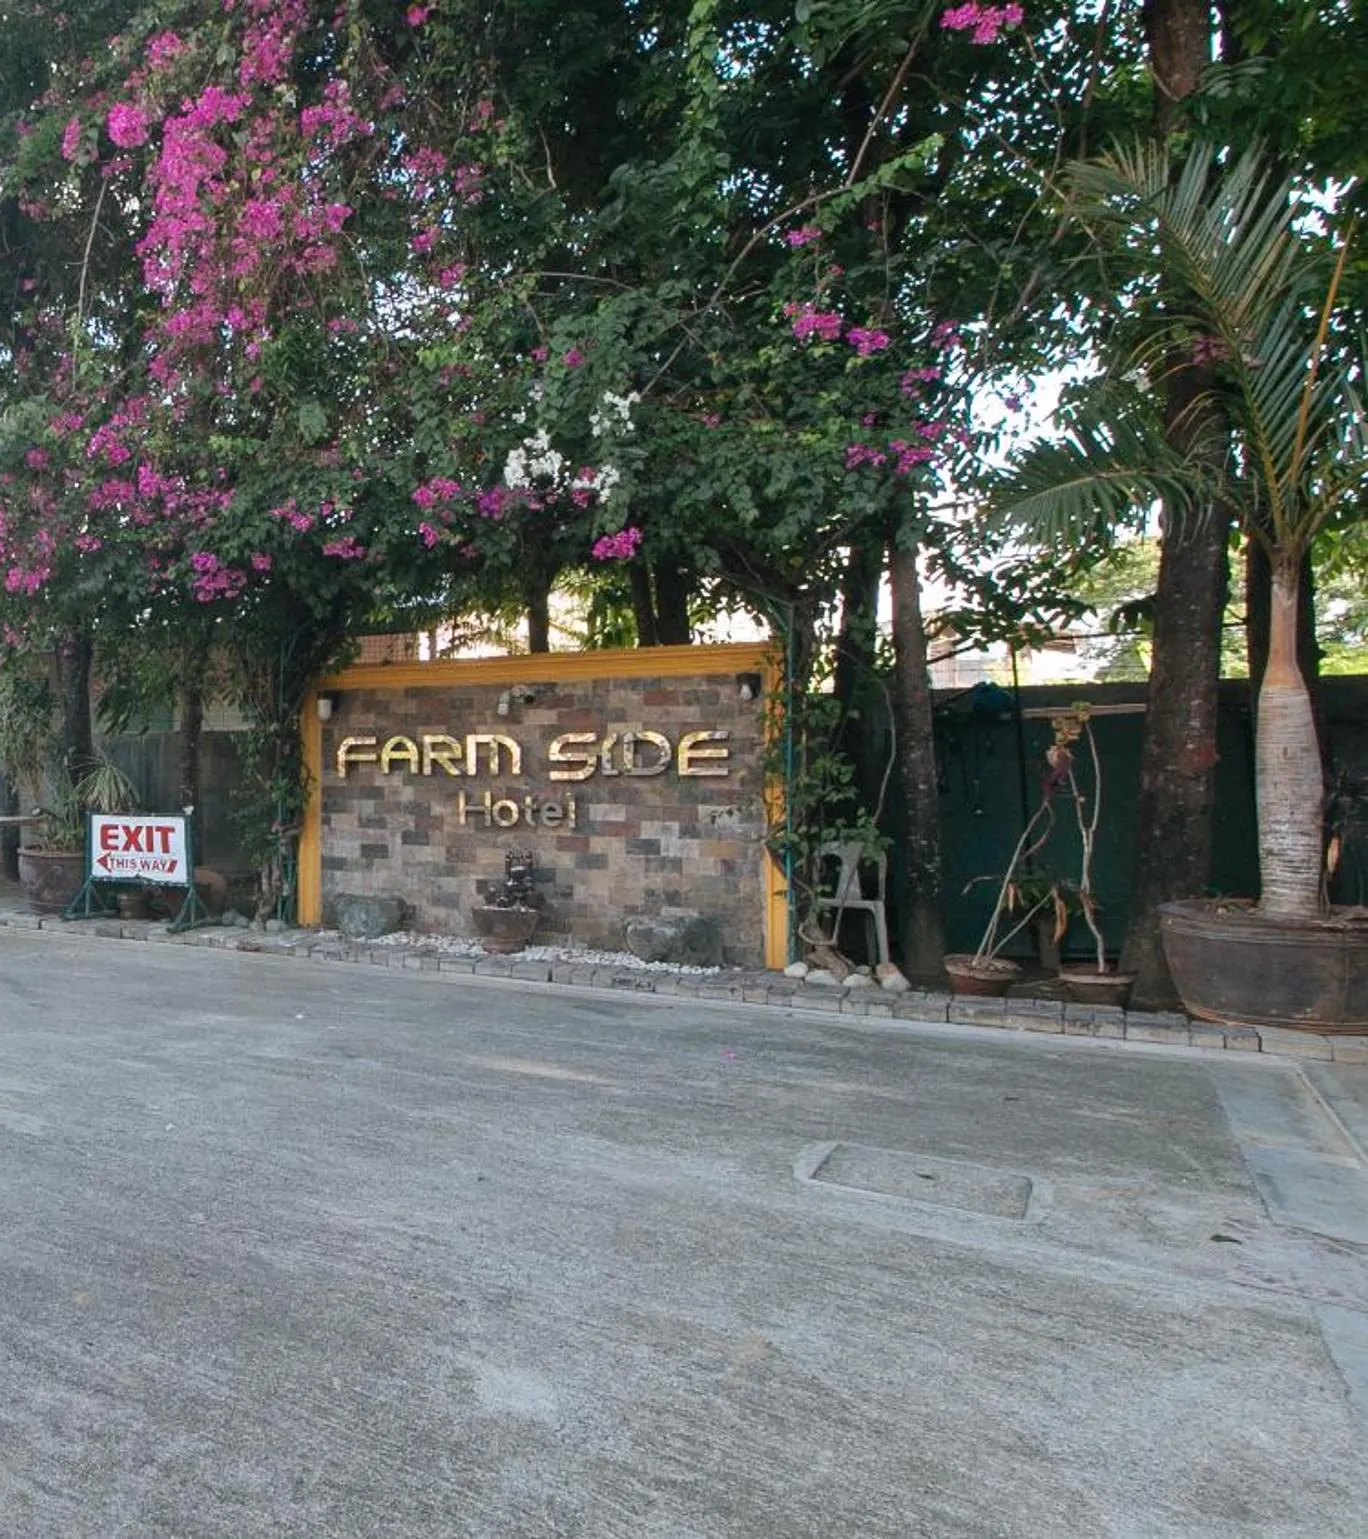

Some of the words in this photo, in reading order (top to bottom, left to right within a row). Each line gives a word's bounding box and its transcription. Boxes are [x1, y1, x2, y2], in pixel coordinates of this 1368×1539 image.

[336, 733, 522, 779] FARM
[548, 729, 731, 782] SIDE
[458, 790, 577, 829] Hotel
[99, 823, 176, 854] EXIT
[109, 857, 138, 870] THIS
[139, 858, 167, 872] WAY
